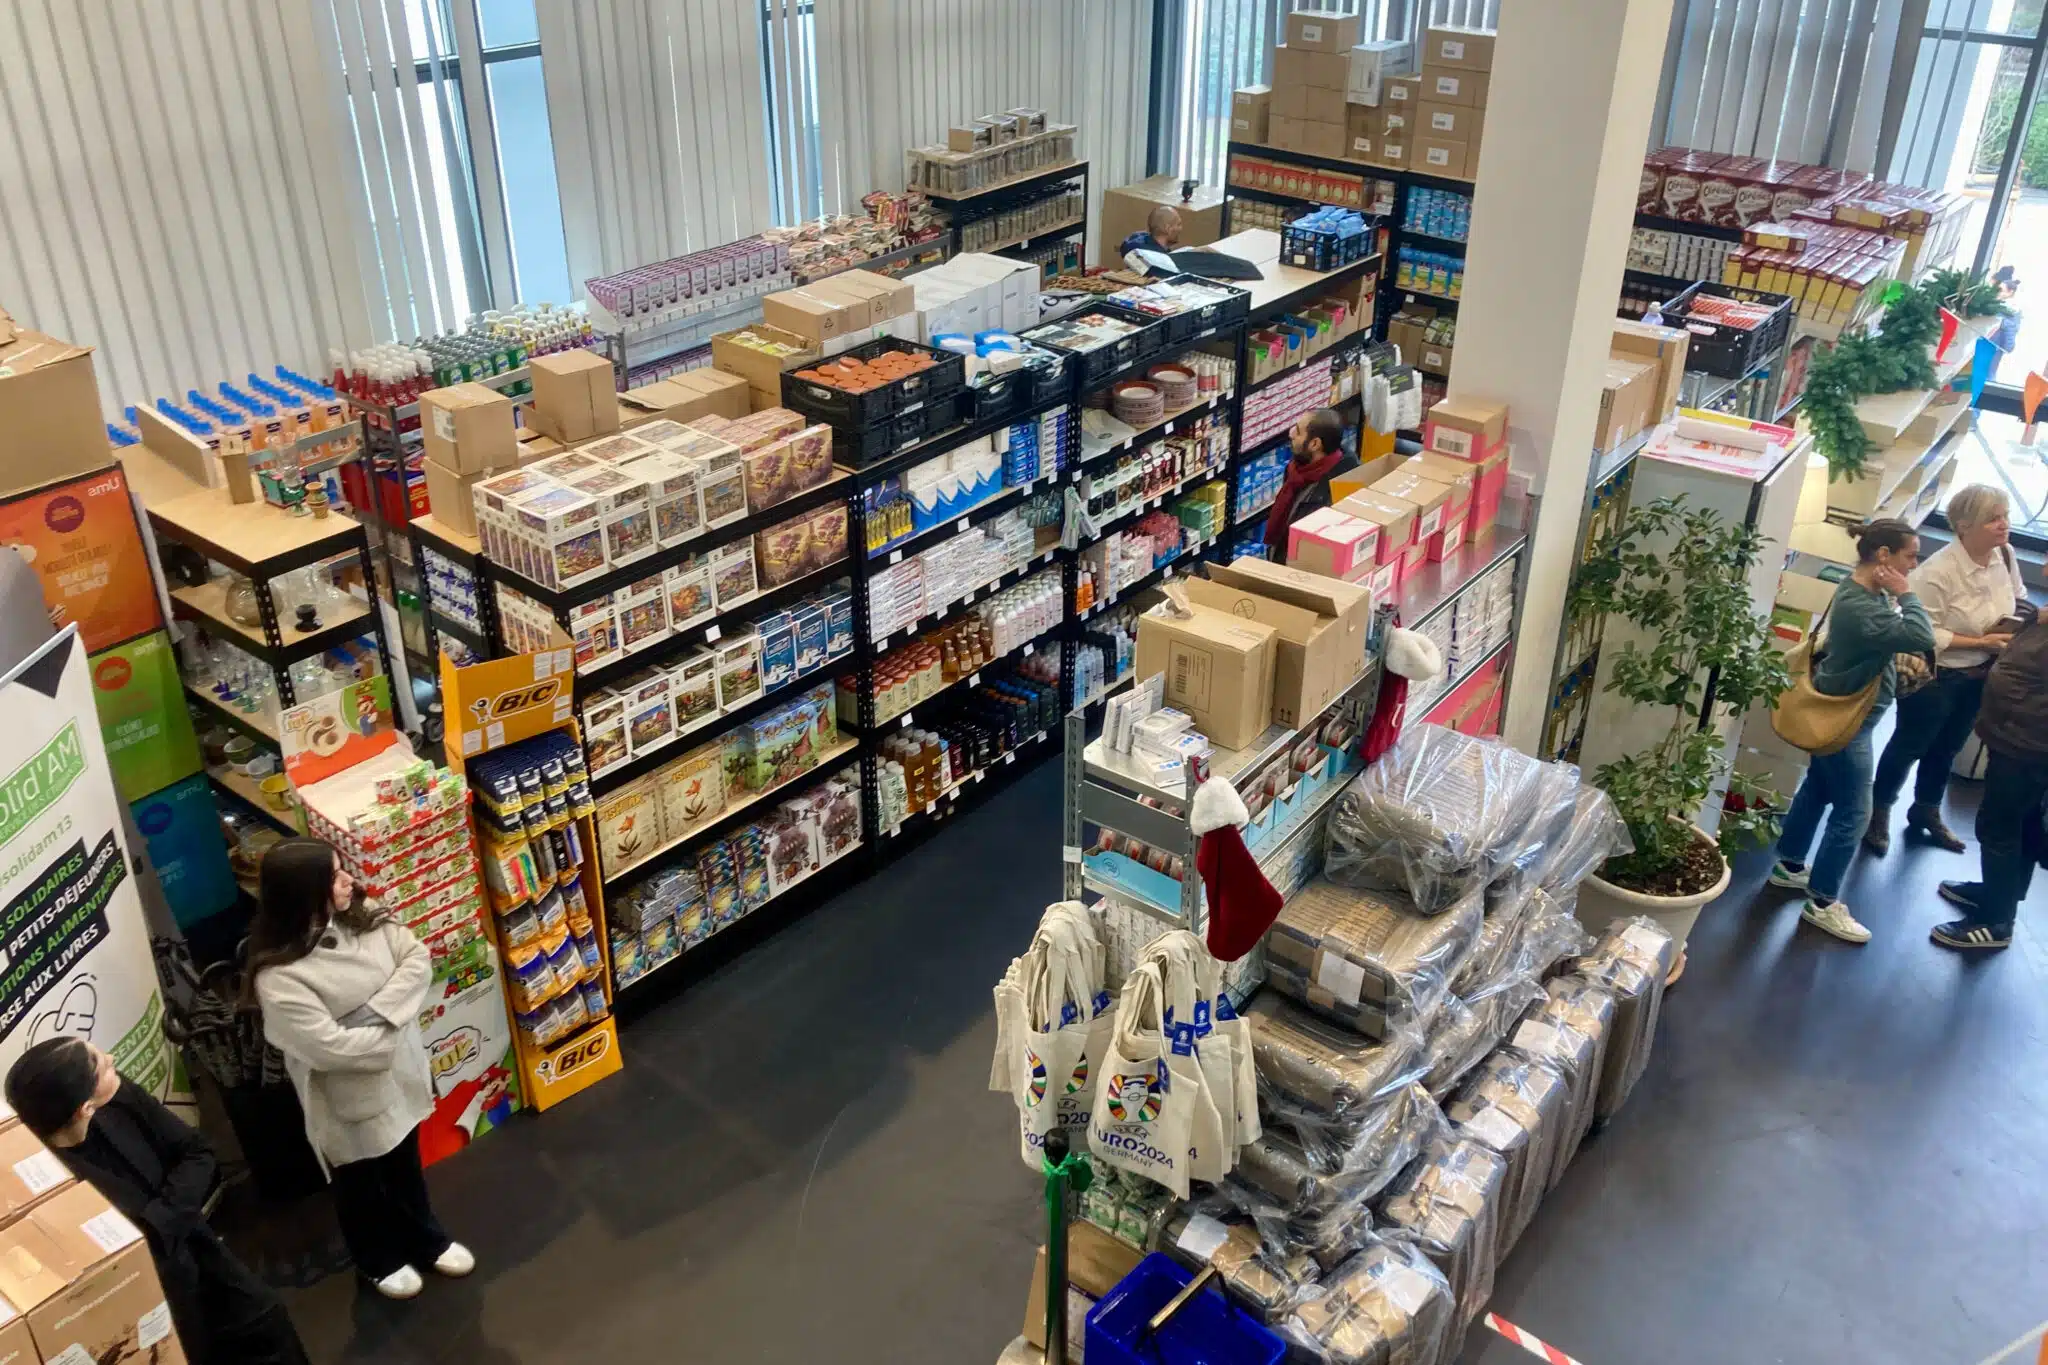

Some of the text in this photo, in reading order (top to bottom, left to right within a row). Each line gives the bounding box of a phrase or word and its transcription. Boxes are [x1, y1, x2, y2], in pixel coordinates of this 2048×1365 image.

[0, 730, 79, 827] olid'AM
[0, 814, 73, 890] solidam13
[6, 852, 84, 930] SOLIDAIRES
[10, 841, 115, 958] PETITS-DÉJEUNERS
[0, 858, 125, 1001] UTIONS ALIMENTAIRES
[0, 922, 100, 1034] RSE AUX LIVRES
[1095, 1121, 1173, 1169] URO2024
